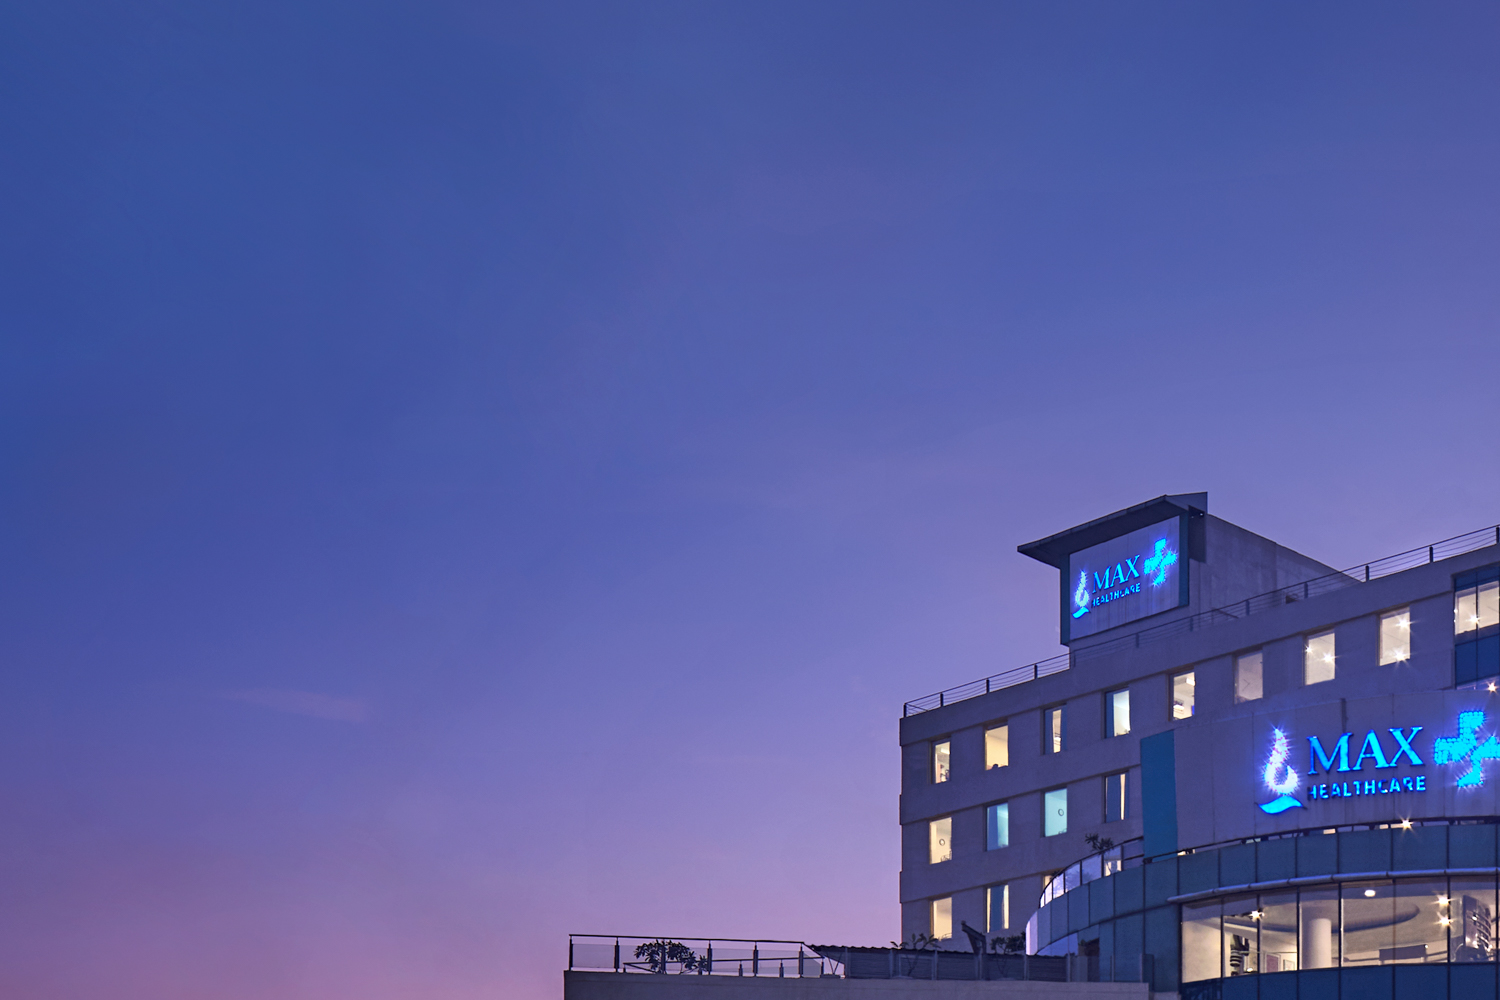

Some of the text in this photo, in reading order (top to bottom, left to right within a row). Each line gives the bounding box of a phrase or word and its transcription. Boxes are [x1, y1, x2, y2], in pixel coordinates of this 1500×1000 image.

[1092, 555, 1140, 594] MAX
[1091, 583, 1141, 608] HEALTHCARE
[1307, 726, 1424, 775] MAX
[1307, 775, 1426, 800] HEALTHCARE
